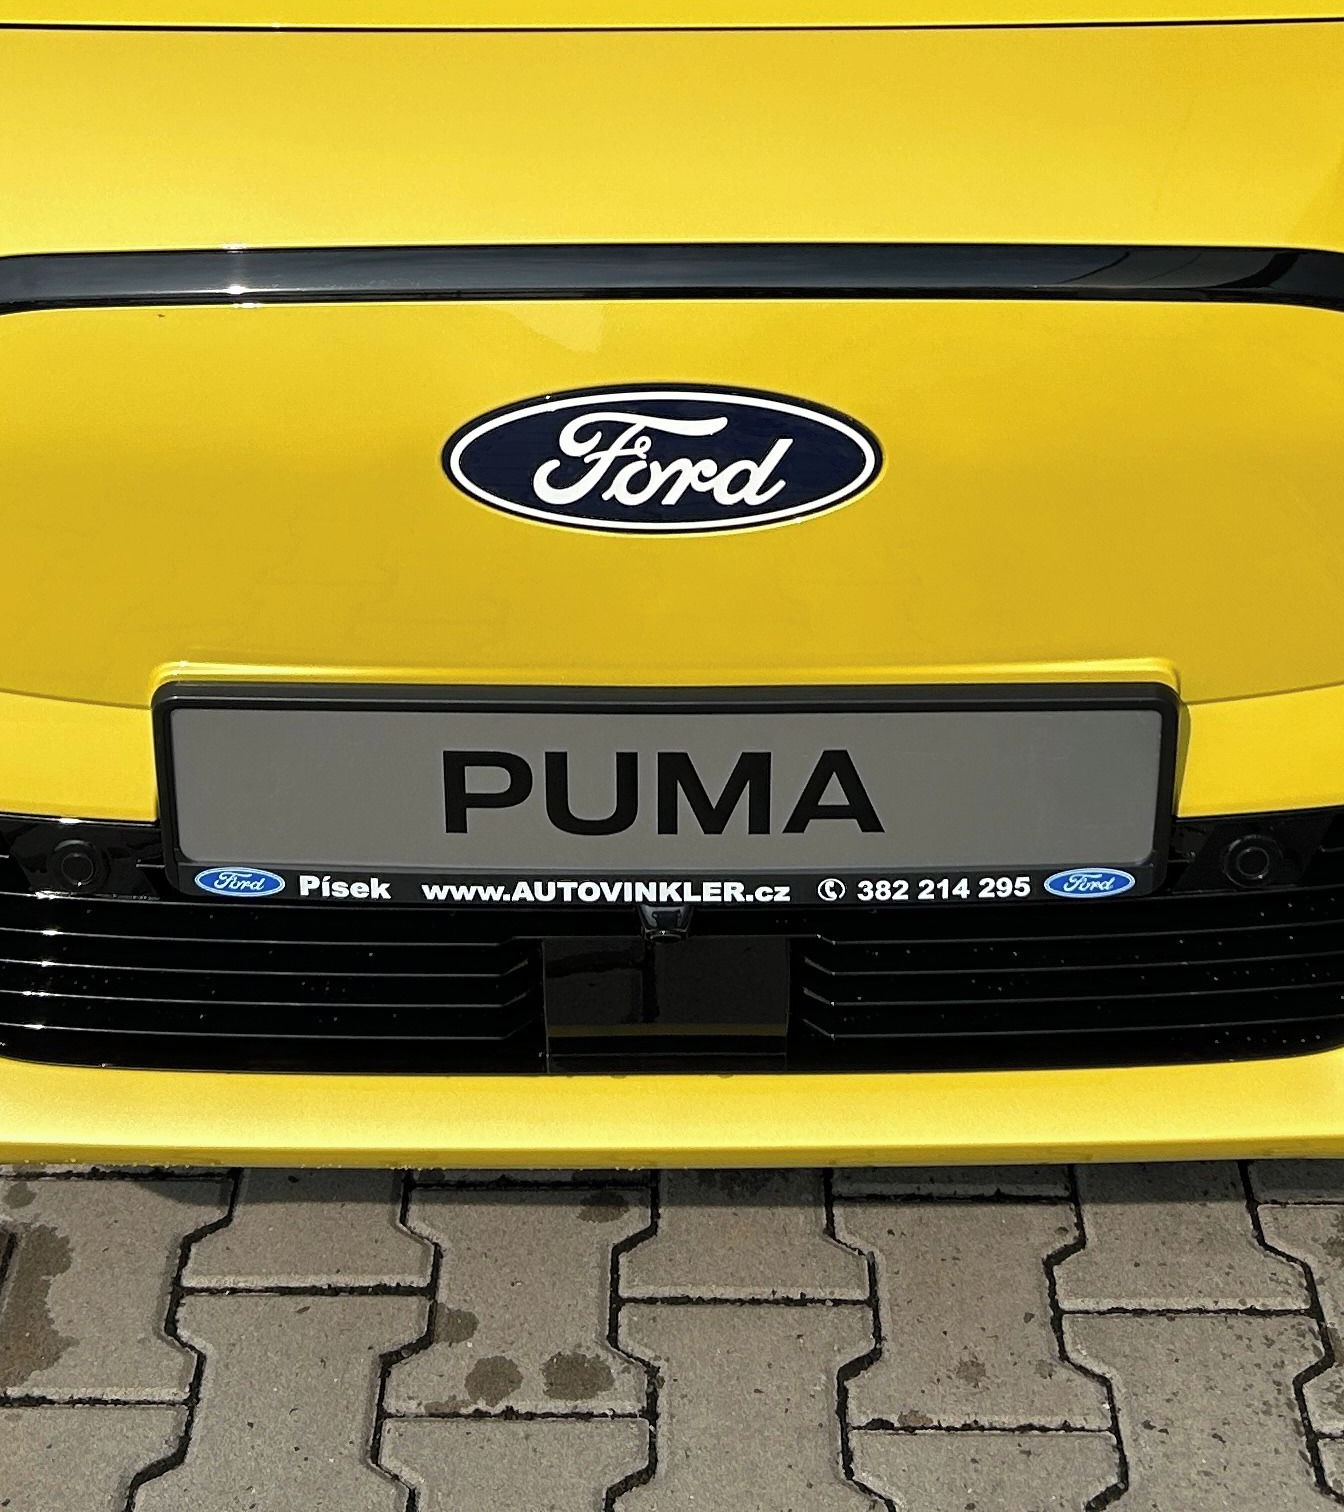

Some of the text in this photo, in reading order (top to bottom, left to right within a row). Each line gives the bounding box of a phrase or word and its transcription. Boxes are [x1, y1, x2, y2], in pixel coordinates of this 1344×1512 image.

[533, 411, 794, 506] Ford
[442, 749, 886, 836] PUMA
[213, 871, 266, 891] Ford
[299, 875, 1031, 903] Písek www.AUTOVINKLER.cz 382 214 295
[1063, 873, 1116, 892] Ford
